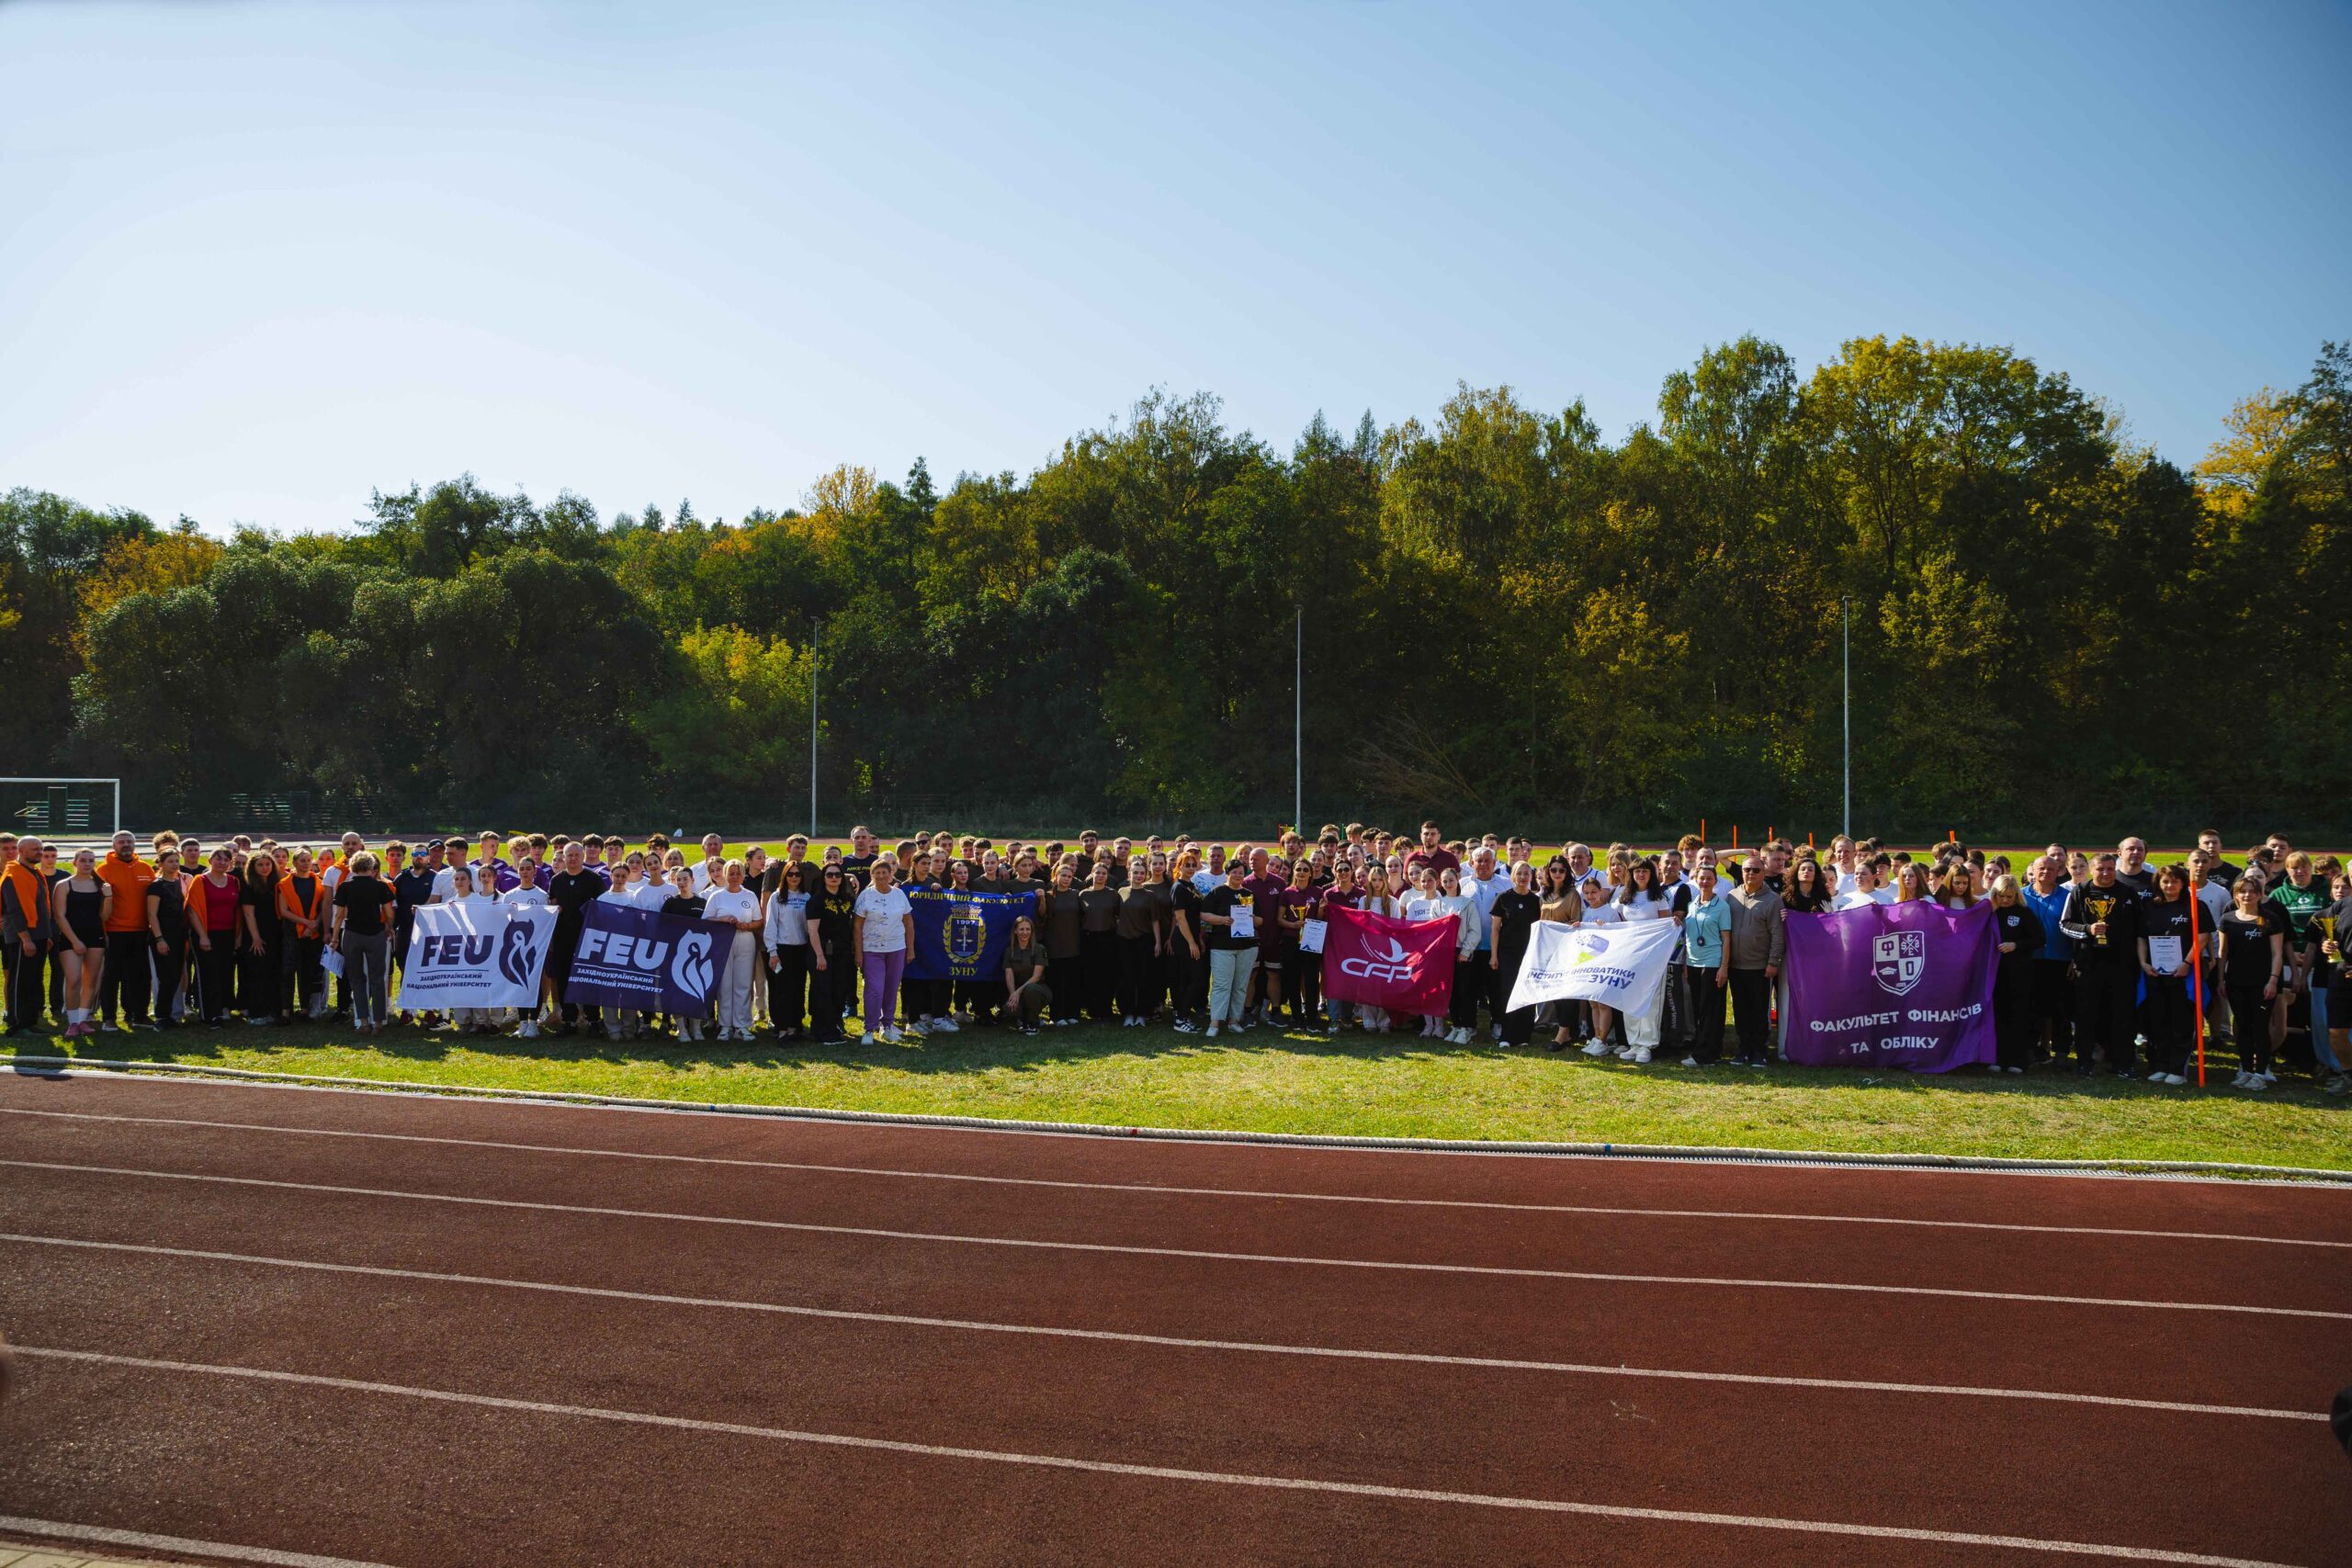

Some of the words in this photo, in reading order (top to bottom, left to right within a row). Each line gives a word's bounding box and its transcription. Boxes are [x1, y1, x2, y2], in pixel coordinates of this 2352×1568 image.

[909, 891, 970, 902] ЮРИДИЧНИЙ
[421, 935, 494, 966] FEU
[578, 928, 669, 970] FEU
[420, 973, 482, 981] ЗАХІДНОУКРАЇНСЬКИЙ
[577, 968, 653, 984] ЗАХІДНОУКРАЇНСЬКИЙ
[949, 967, 978, 976] ЗУНУ
[569, 976, 616, 987] АЦІОНАЛЬНИЙ
[616, 982, 663, 993] УНІВЕРСИТЕТ
[1588, 974, 1632, 989] ЗУНУ
[1810, 1011, 1899, 1032] ФАКУЛЬТЕТ
[1907, 1003, 1982, 1022] ФІНАНСІВ
[1850, 1042, 1870, 1054] ТА
[1881, 1036, 1939, 1050] ОБЛІКУ
